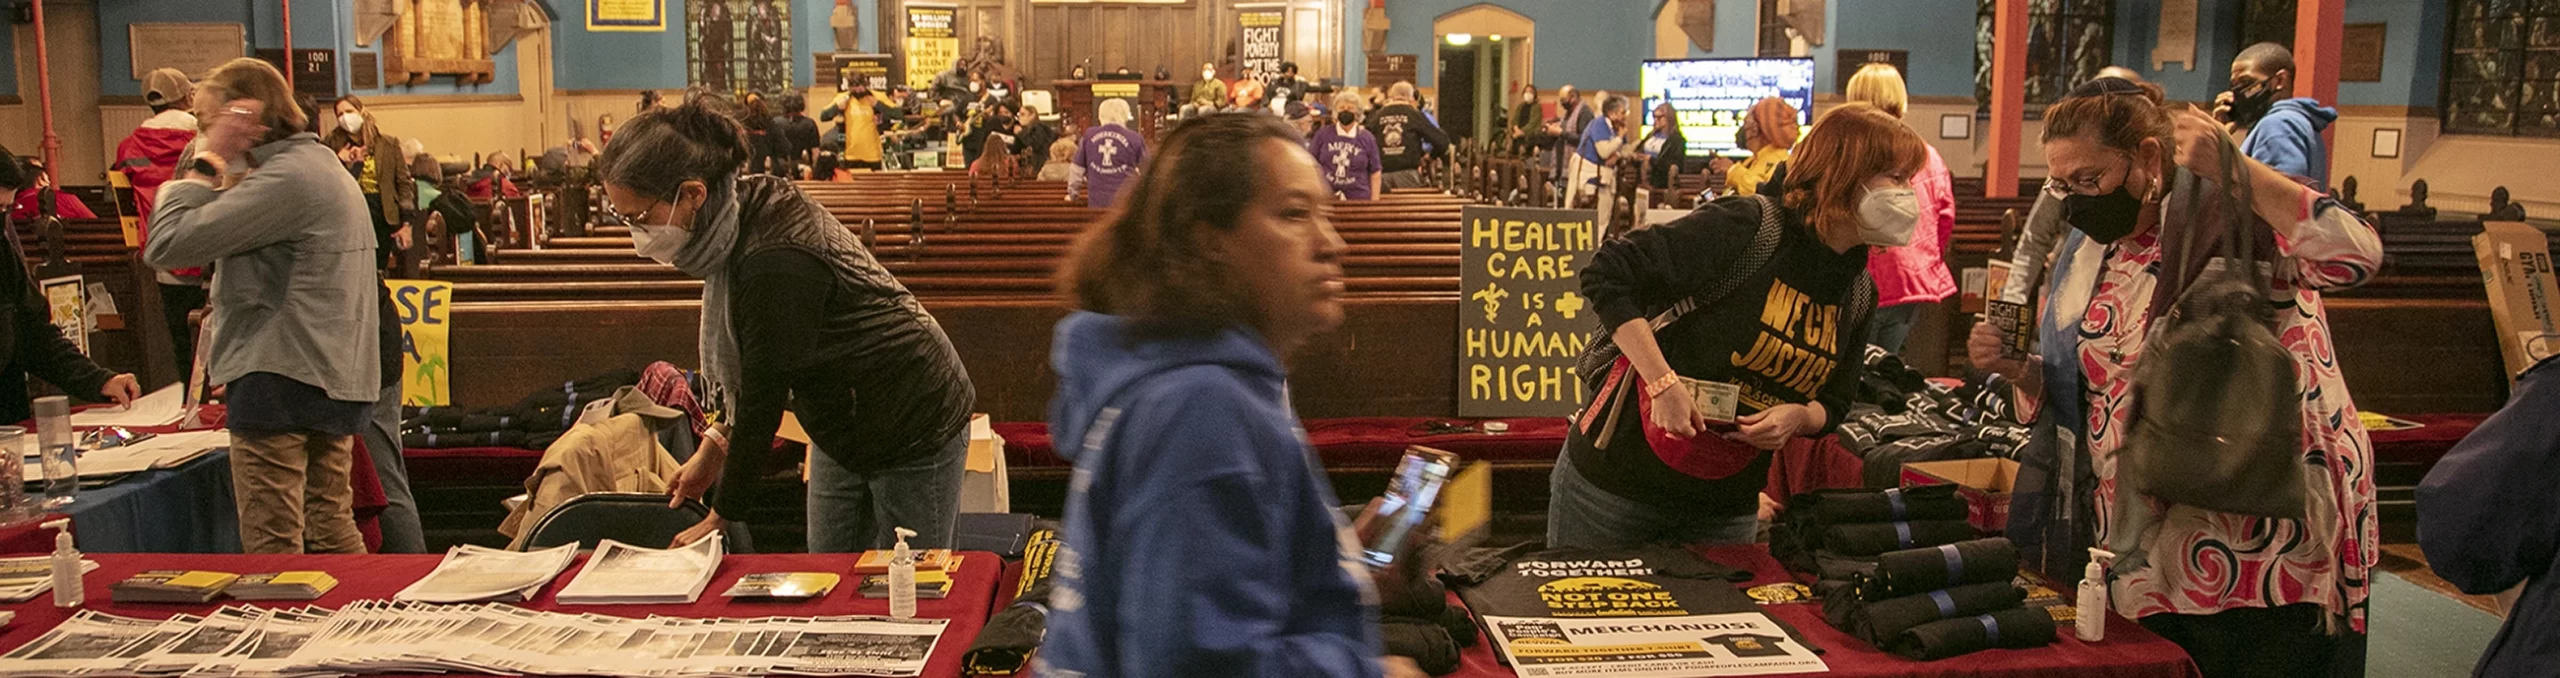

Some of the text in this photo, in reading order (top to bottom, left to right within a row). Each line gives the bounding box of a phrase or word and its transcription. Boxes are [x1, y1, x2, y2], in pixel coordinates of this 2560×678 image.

[1243, 27, 1279, 43] FIGHT
[308, 52, 329, 62] 1001
[1243, 41, 1279, 57] POVERTY
[308, 62, 320, 73] 21
[1472, 218, 1593, 251] HEALTH
[1487, 252, 1575, 281] CARE
[1522, 292, 1545, 310] IS
[1760, 277, 1811, 340] WE
[1526, 312, 1543, 328] A
[1466, 328, 1591, 358] HUMAN
[1730, 330, 1838, 400] JUSTICE
[1471, 364, 1582, 404] RIGHT
[1517, 559, 1644, 569] FORWARD
[1518, 568, 1653, 577] TOGETHER!
[1540, 591, 1672, 601] NOT ONE
[1547, 600, 1680, 609] STEP BACK
[1569, 622, 1760, 635] MERCHANDISE
